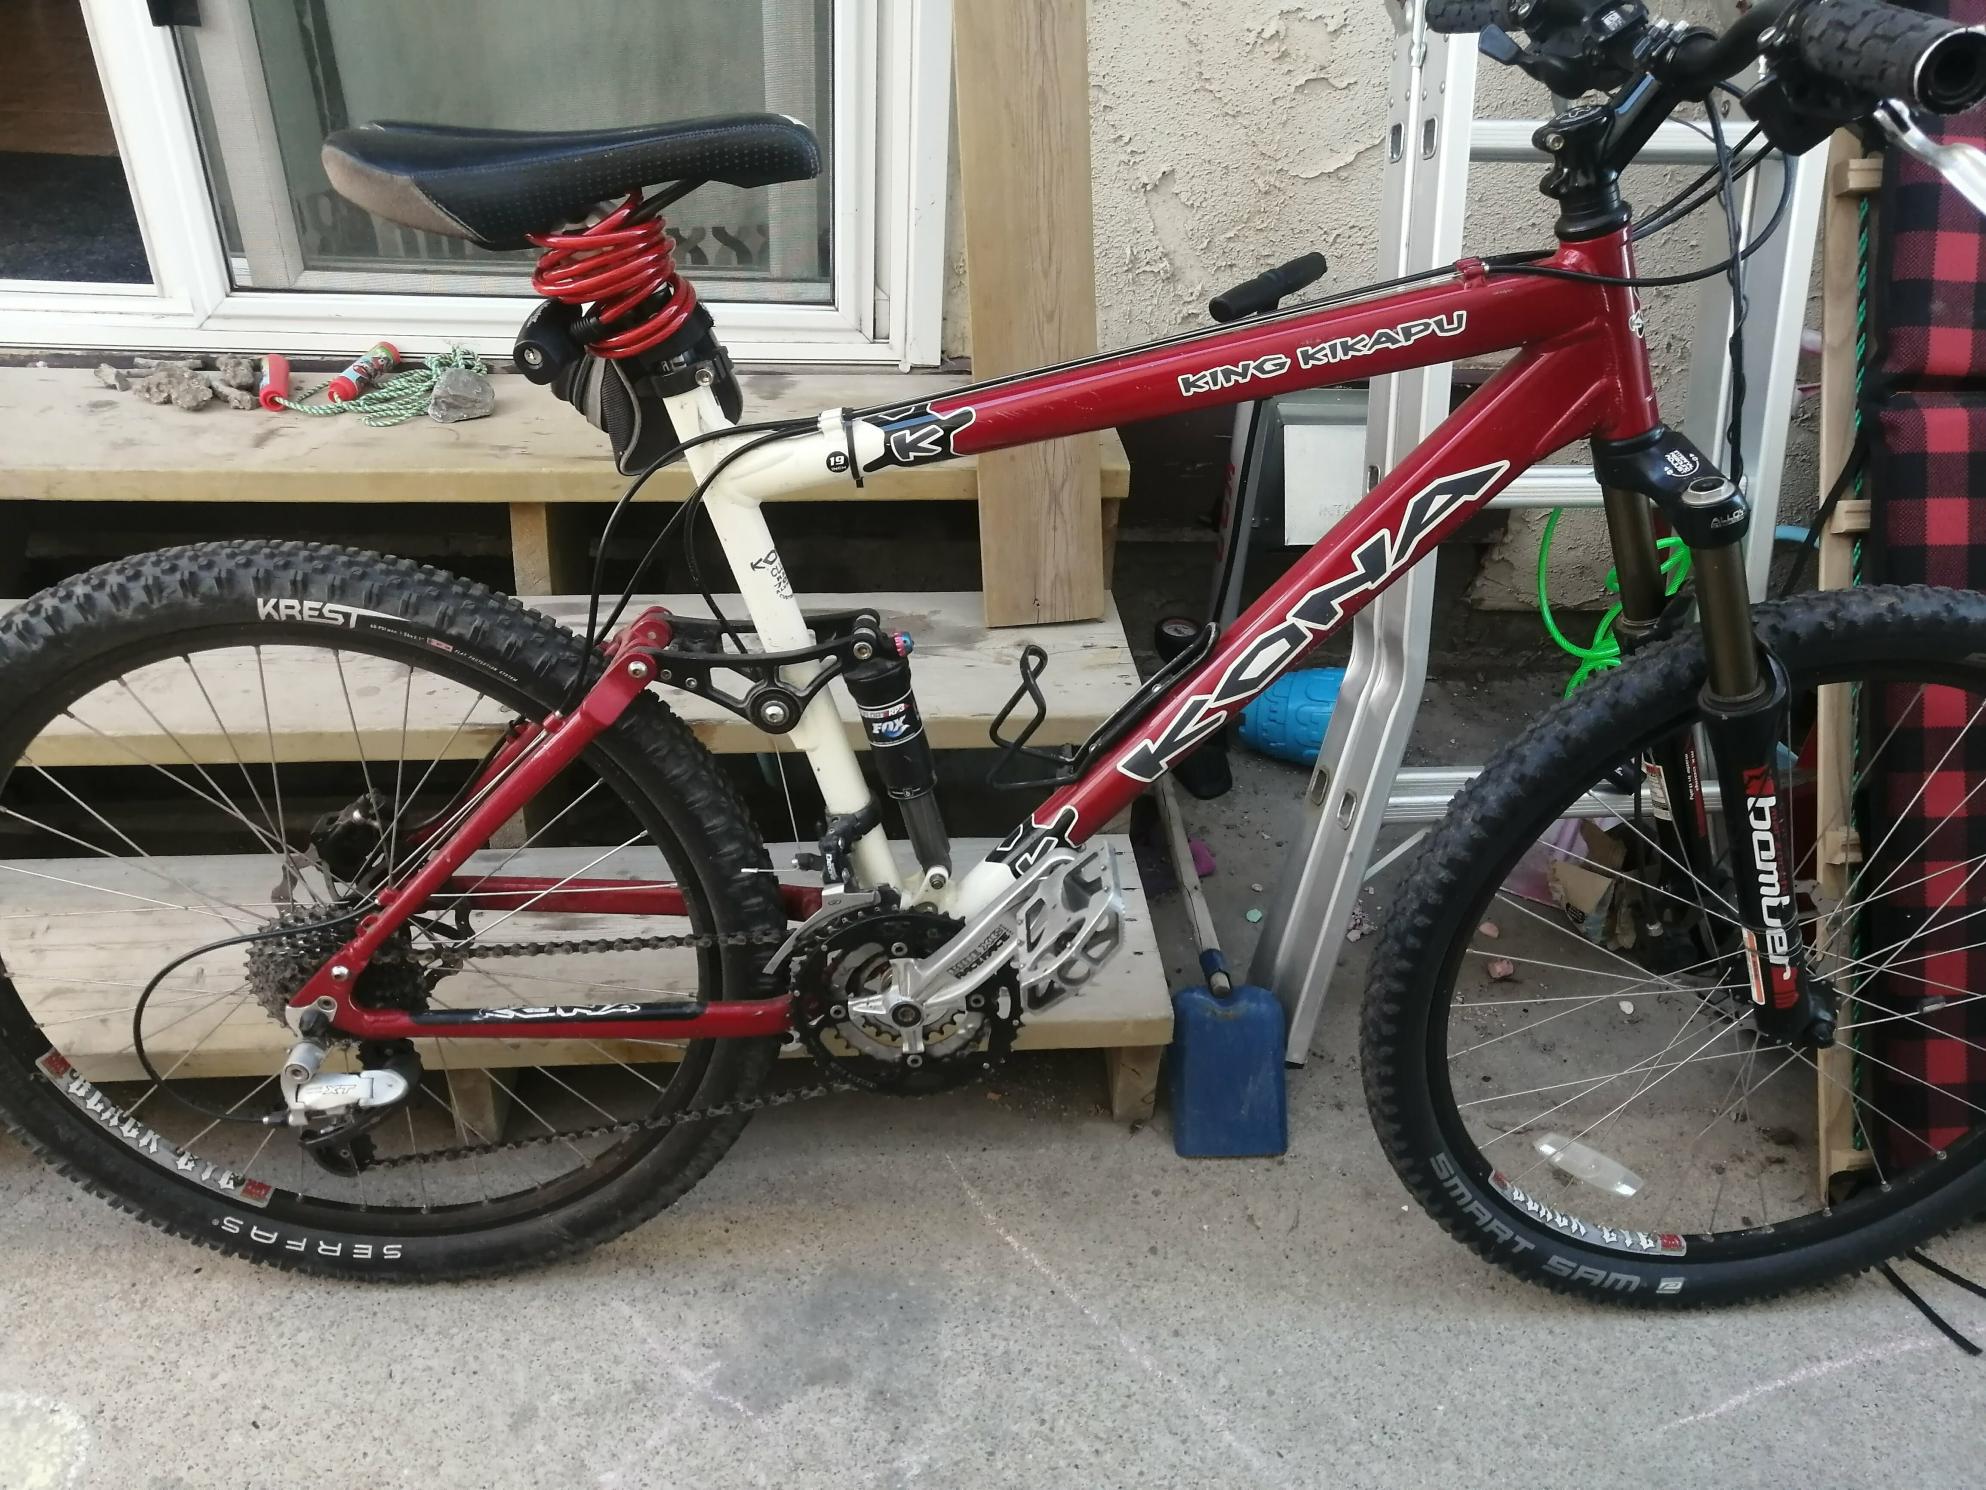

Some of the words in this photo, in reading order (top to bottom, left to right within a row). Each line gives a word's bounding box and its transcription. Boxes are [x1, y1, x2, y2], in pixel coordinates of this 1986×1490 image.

[1178, 354, 1290, 397] KING
[1296, 310, 1468, 369] KIKAPU
[829, 456, 845, 466] 19
[257, 597, 408, 629] KREST
[1117, 460, 1511, 783] KONA
[872, 714, 910, 737] FOX
[1746, 796, 1791, 980] bomber
[955, 957, 983, 979] RACE
[980, 932, 1010, 961] FACE
[321, 1084, 357, 1095] XT
[220, 1215, 403, 1260] SERFAS
[1429, 1152, 1536, 1254] SMART
[1541, 1255, 1642, 1293] SAM
